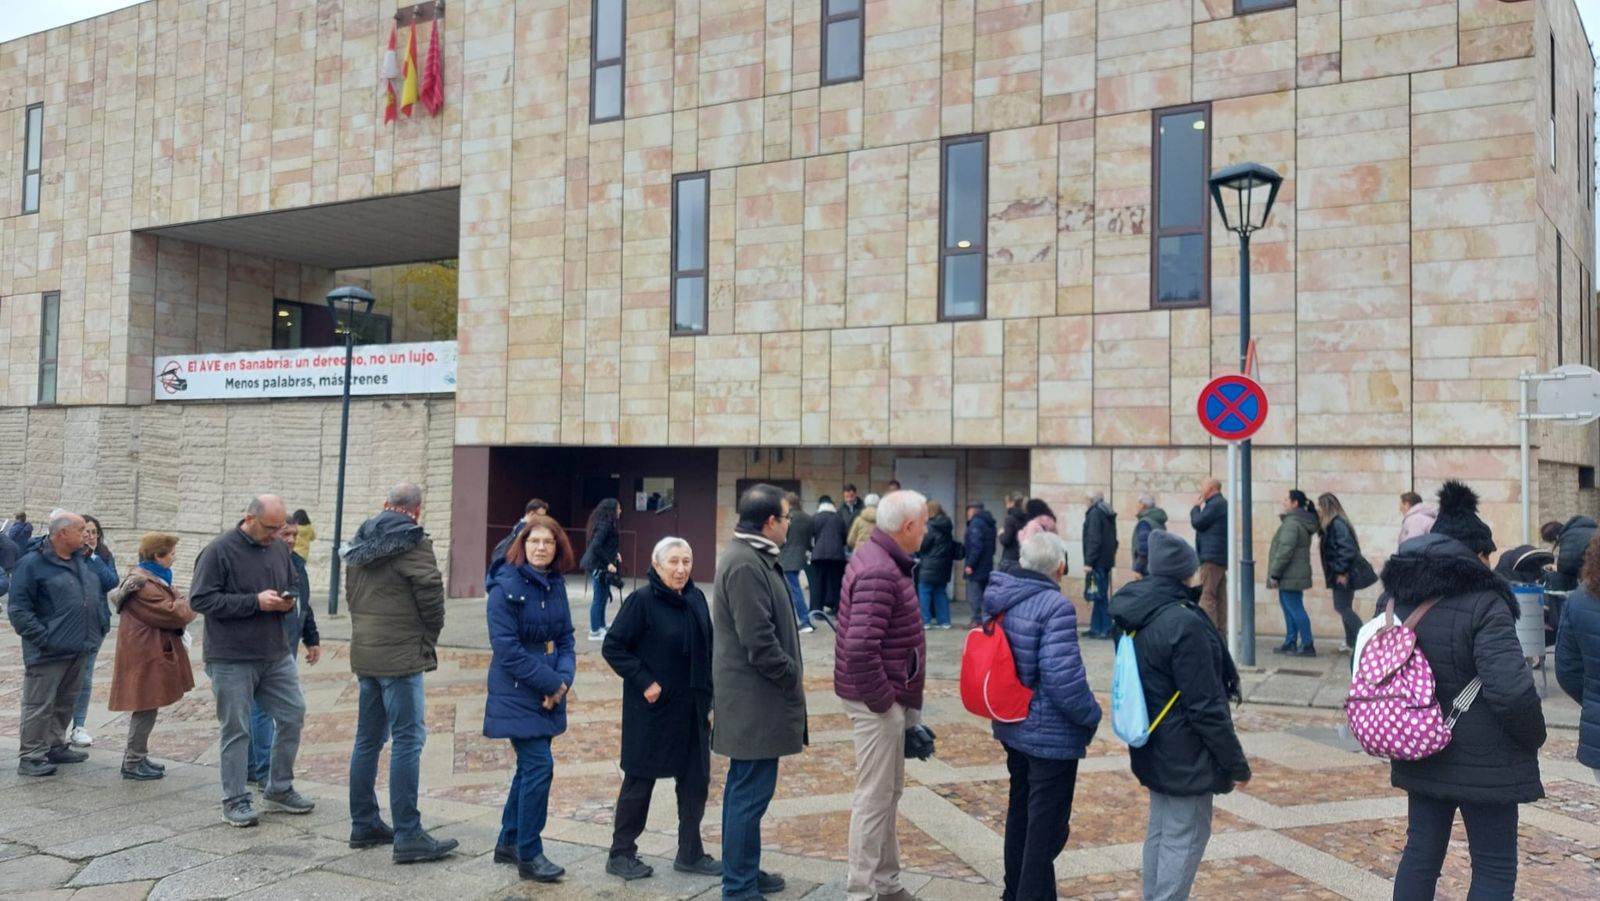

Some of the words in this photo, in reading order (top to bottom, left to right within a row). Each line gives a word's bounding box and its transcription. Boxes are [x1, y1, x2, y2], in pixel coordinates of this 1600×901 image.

[187, 360, 197, 373] El
[199, 360, 220, 372] AVE
[223, 361, 237, 371] en
[239, 356, 293, 370] Sanabria:
[295, 357, 309, 369] un
[369, 354, 386, 365] no
[390, 353, 406, 364] un
[409, 348, 438, 366] lujo.
[225, 378, 260, 390] Menos
[263, 375, 316, 391] palabras,
[319, 373, 345, 387] más
